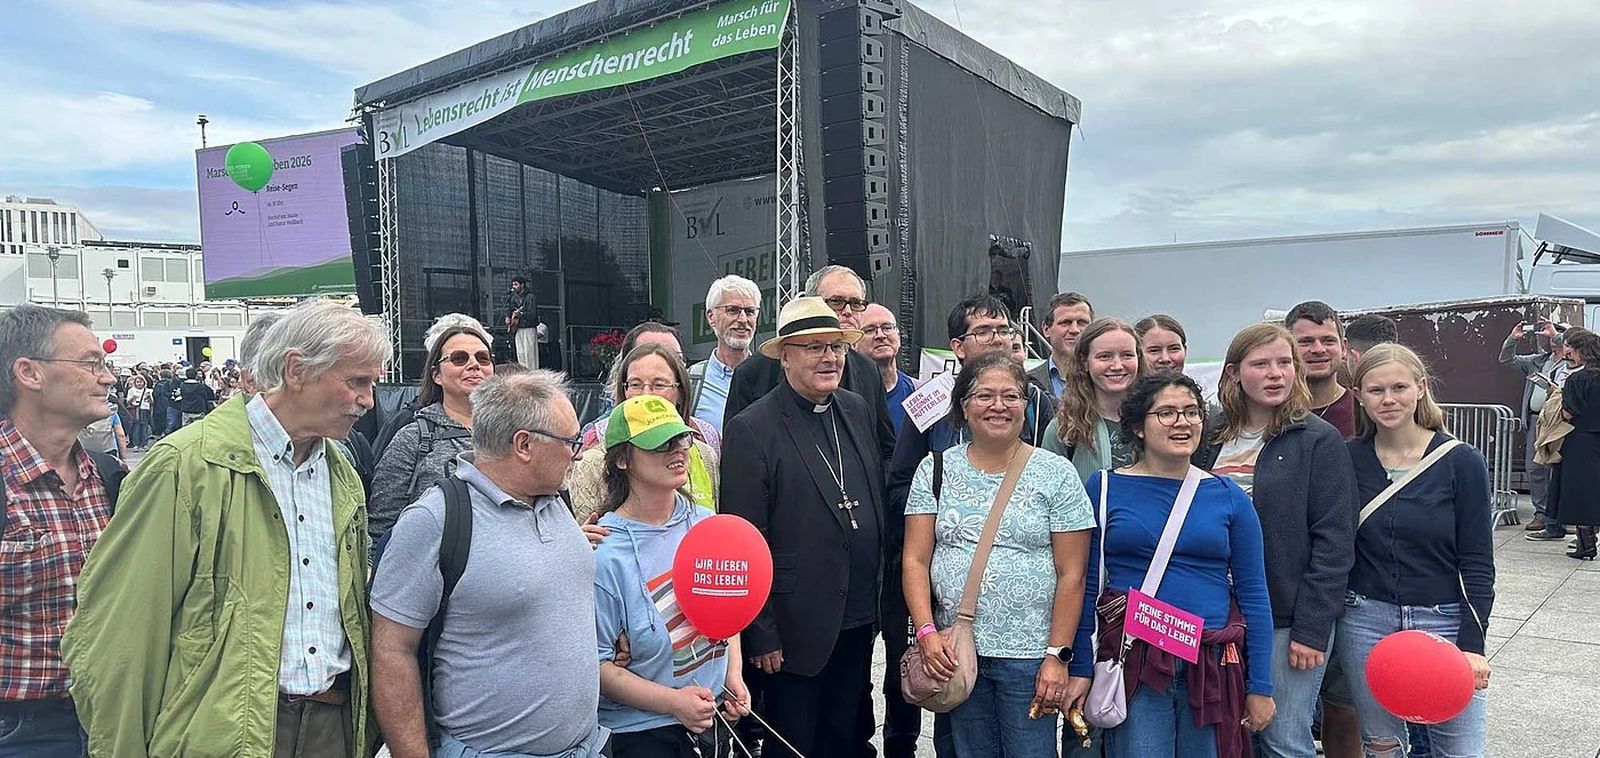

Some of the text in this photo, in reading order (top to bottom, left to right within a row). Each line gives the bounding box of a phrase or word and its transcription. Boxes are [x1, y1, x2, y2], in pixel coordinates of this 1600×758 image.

[717, 1, 780, 28] Marsch für
[712, 23, 776, 48] das Leben
[415, 29, 693, 135] Lebensrecht ist Menschenrecht
[291, 155, 312, 169] 2026
[906, 392, 924, 408] LEBEN
[910, 389, 941, 414] BEGINNT IM
[914, 393, 947, 420] MUTTERLEIB
[695, 558, 748, 572] WIR LIEBEN
[694, 572, 748, 586] DAS LEBEN!
[1134, 611, 1197, 648] FÜR DAS LEBEN
[1138, 601, 1197, 635] MEINE STIMME
